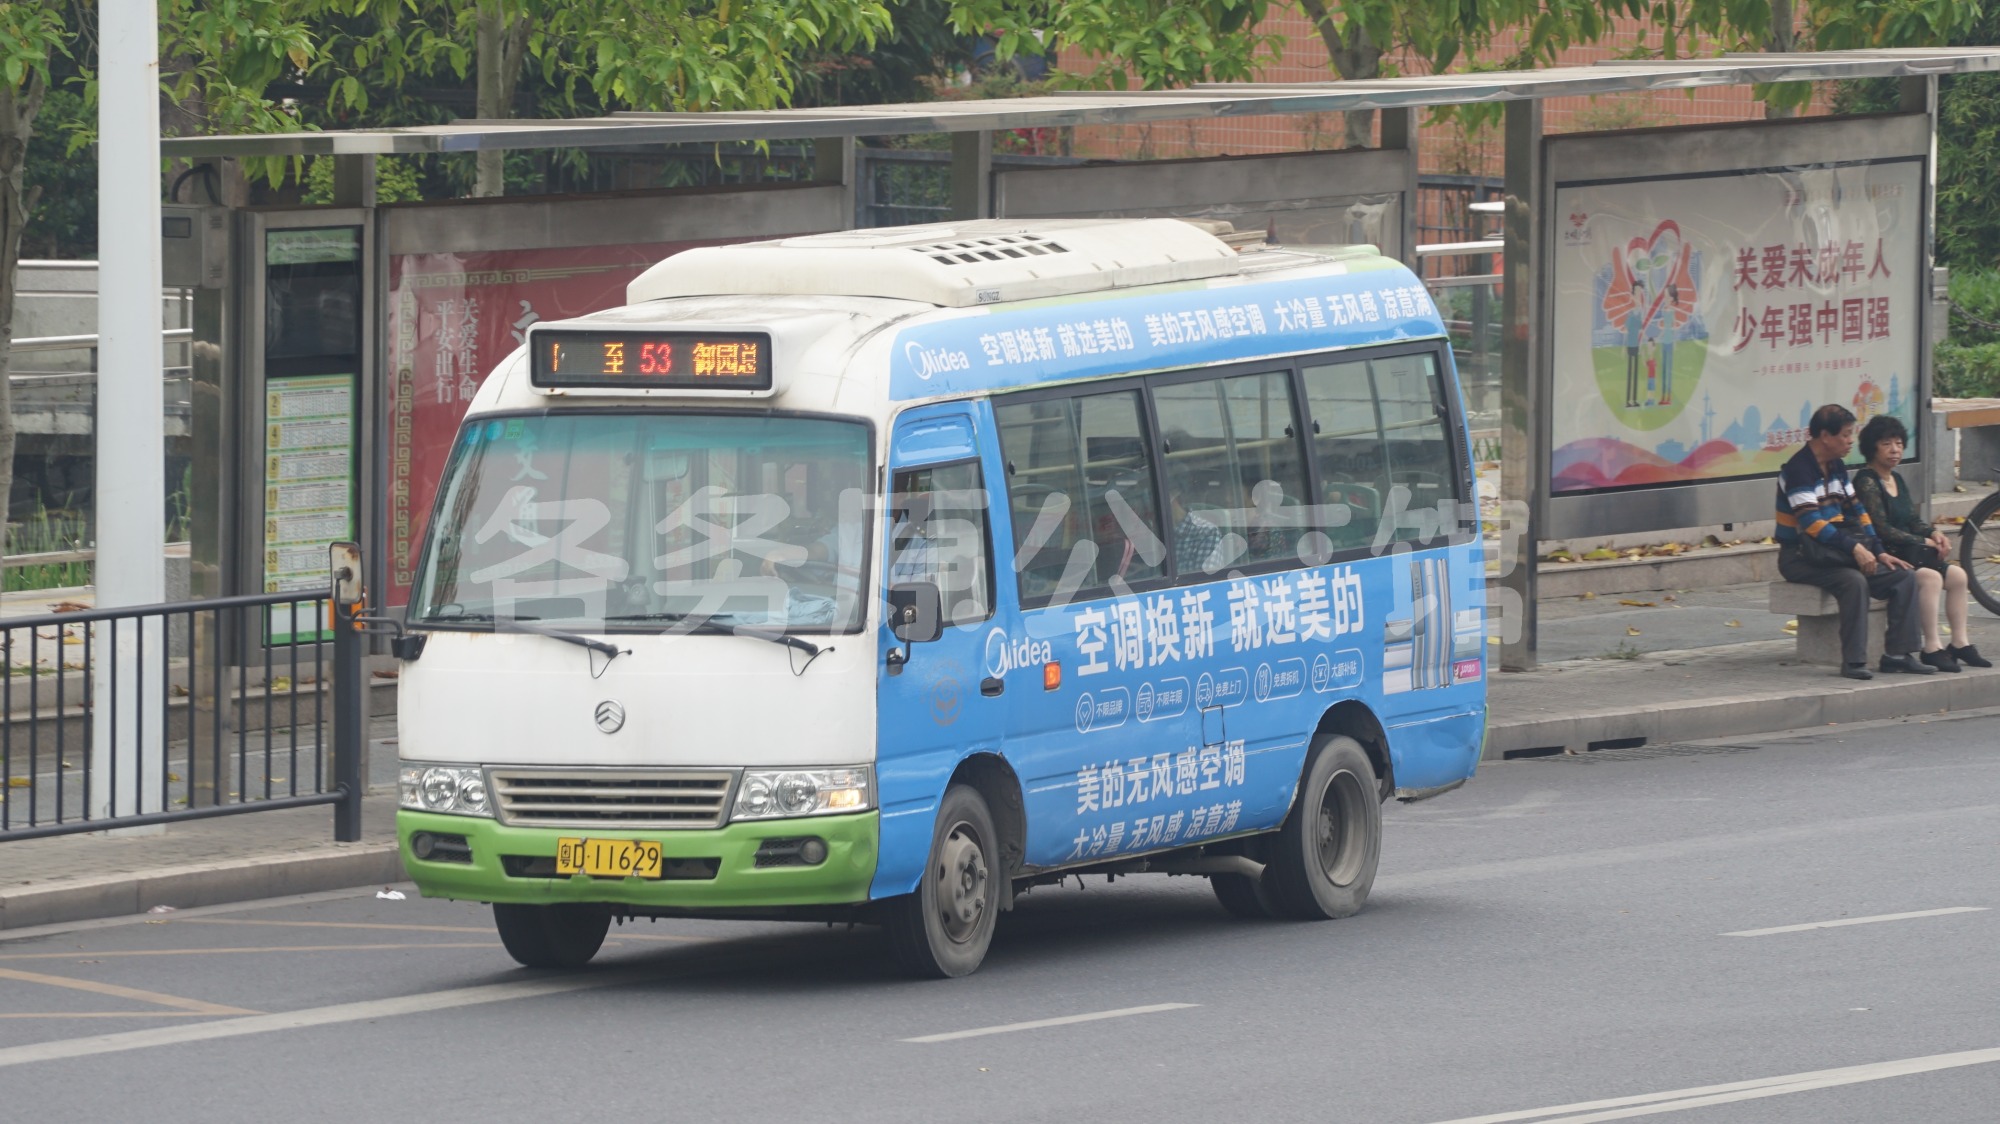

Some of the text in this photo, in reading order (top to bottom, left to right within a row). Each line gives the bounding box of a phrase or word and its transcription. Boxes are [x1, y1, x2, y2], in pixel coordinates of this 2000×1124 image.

[1733, 238, 1891, 292] 关爱未成年人
[1144, 304, 1267, 347] 美的无风感空调
[1273, 285, 1433, 332] 大冷量 无风感 凉意满
[1733, 296, 1891, 352] 少年强中国强
[435, 299, 455, 403] 平安出行
[458, 297, 480, 402] 关爱生命
[603, 342, 624, 374] 至
[640, 342, 673, 374] 53
[904, 341, 970, 380] Midea
[979, 317, 1135, 366] 空调换新 就选美的
[1074, 565, 1364, 677] 空调换新 就选美的
[986, 627, 1052, 679] Midea
[1096, 699, 1123, 718] 不限品牌
[1155, 689, 1183, 708] 不限年限
[1215, 680, 1242, 697] 免费上门
[1076, 739, 1245, 815] 美的无风感空调
[1065, 799, 1243, 861] 大冷量 无风感 凉意满
